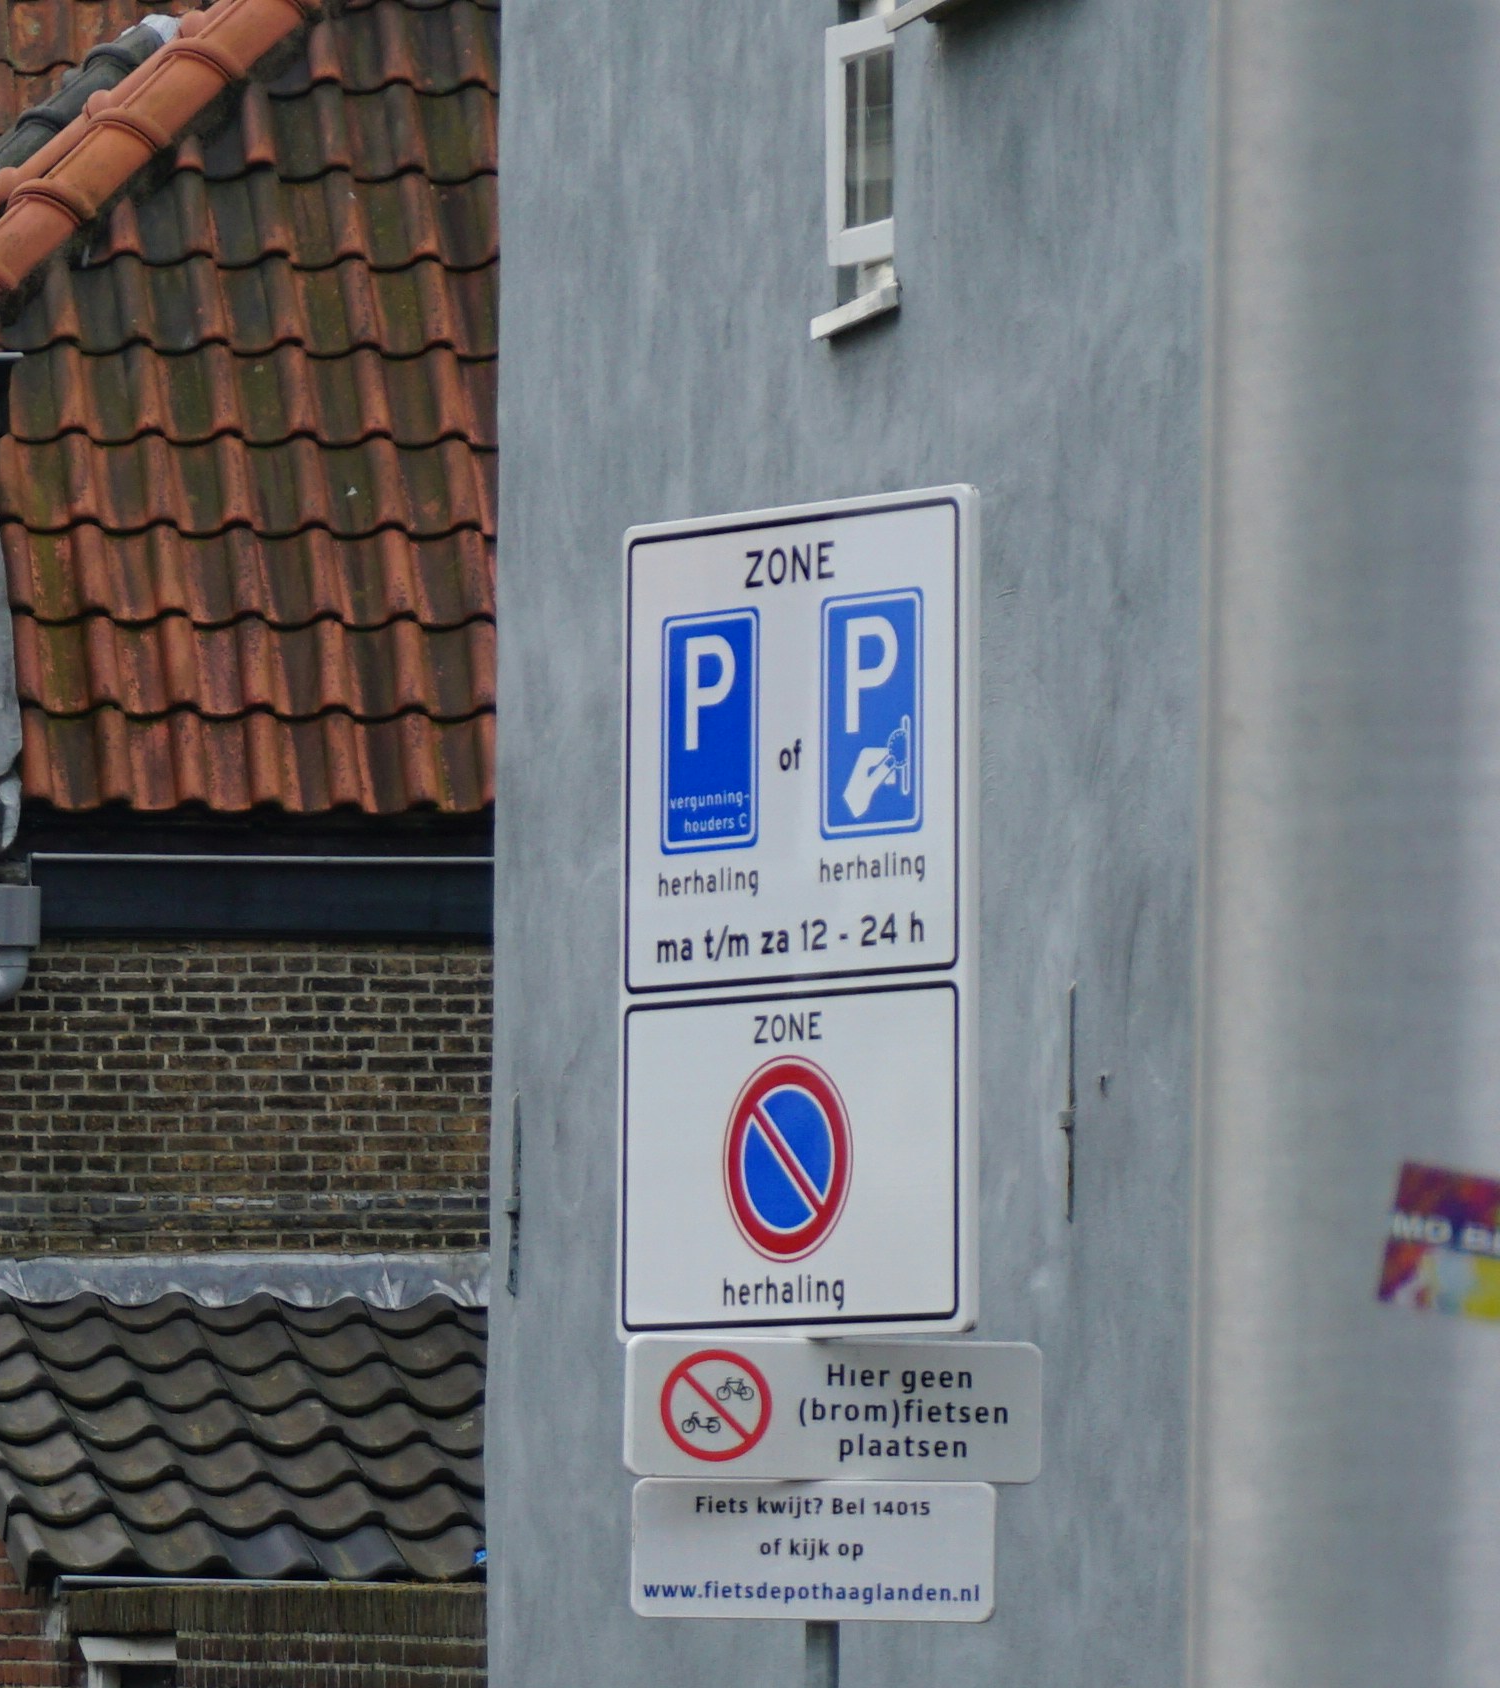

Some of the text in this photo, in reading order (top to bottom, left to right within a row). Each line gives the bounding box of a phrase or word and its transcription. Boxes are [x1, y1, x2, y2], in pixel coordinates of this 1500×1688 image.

[744, 541, 835, 588] ZONE
[845, 615, 898, 734] P
[684, 634, 737, 751] P
[778, 738, 802, 772] of
[670, 789, 751, 812] vergunning-
[684, 812, 747, 833] houders C
[657, 866, 760, 898] herhaling
[818, 851, 926, 884] herhaling
[656, 932, 693, 963] ma
[704, 925, 749, 961] t/m
[760, 928, 790, 954] za
[801, 919, 827, 951] 12
[861, 914, 896, 945] 24
[910, 911, 924, 943] h
[753, 1011, 823, 1044] ZONE
[722, 1275, 846, 1310] herhaling
[827, 1364, 974, 1394] Hier geen
[798, 1397, 1009, 1427] (brom)fietsen
[838, 1433, 968, 1462] plaatsen
[695, 1495, 931, 1520] Fiets kwijt? Bel 14015
[760, 1537, 864, 1562] of kijk op
[643, 1580, 980, 1604] www.fietsdepothaaglanden.nl
